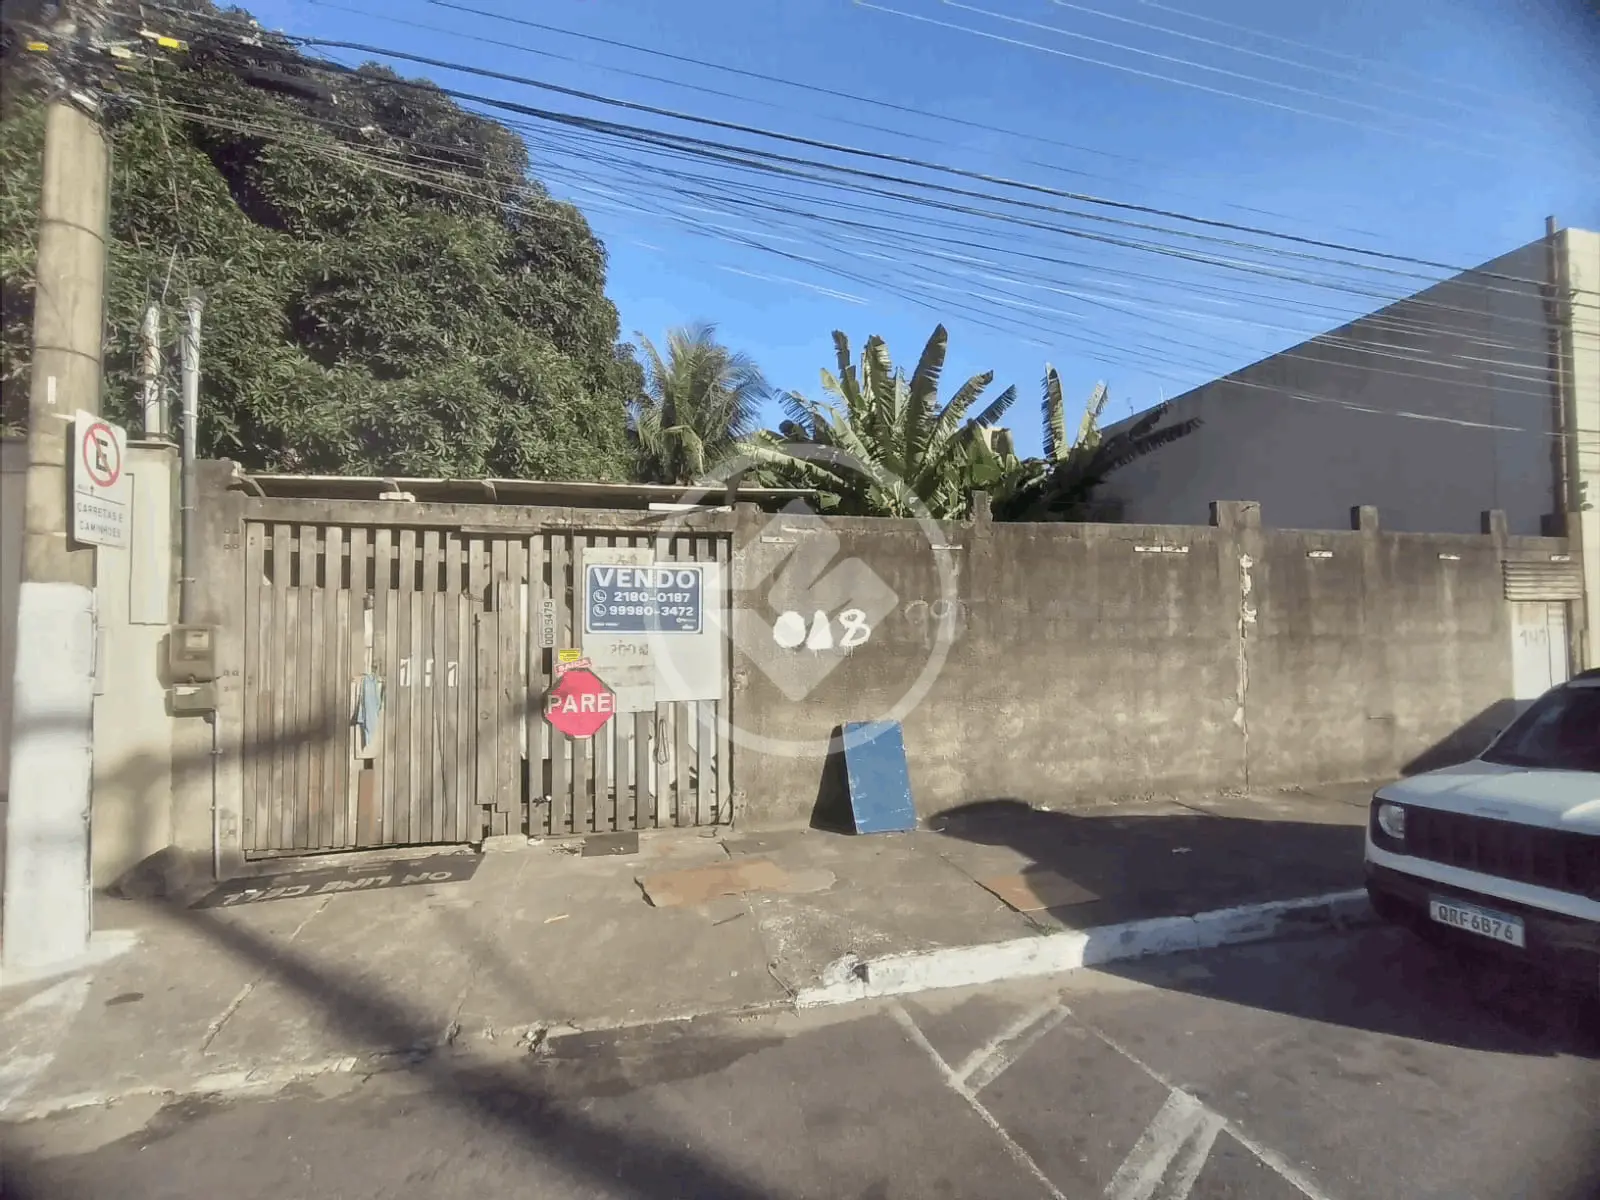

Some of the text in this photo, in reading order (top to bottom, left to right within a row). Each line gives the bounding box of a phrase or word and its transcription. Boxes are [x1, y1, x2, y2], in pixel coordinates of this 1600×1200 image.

[593, 567, 696, 589] VENDO
[608, 605, 694, 617] 99980-3472
[547, 692, 611, 715] PARE
[1438, 905, 1514, 941] QRF6B76
